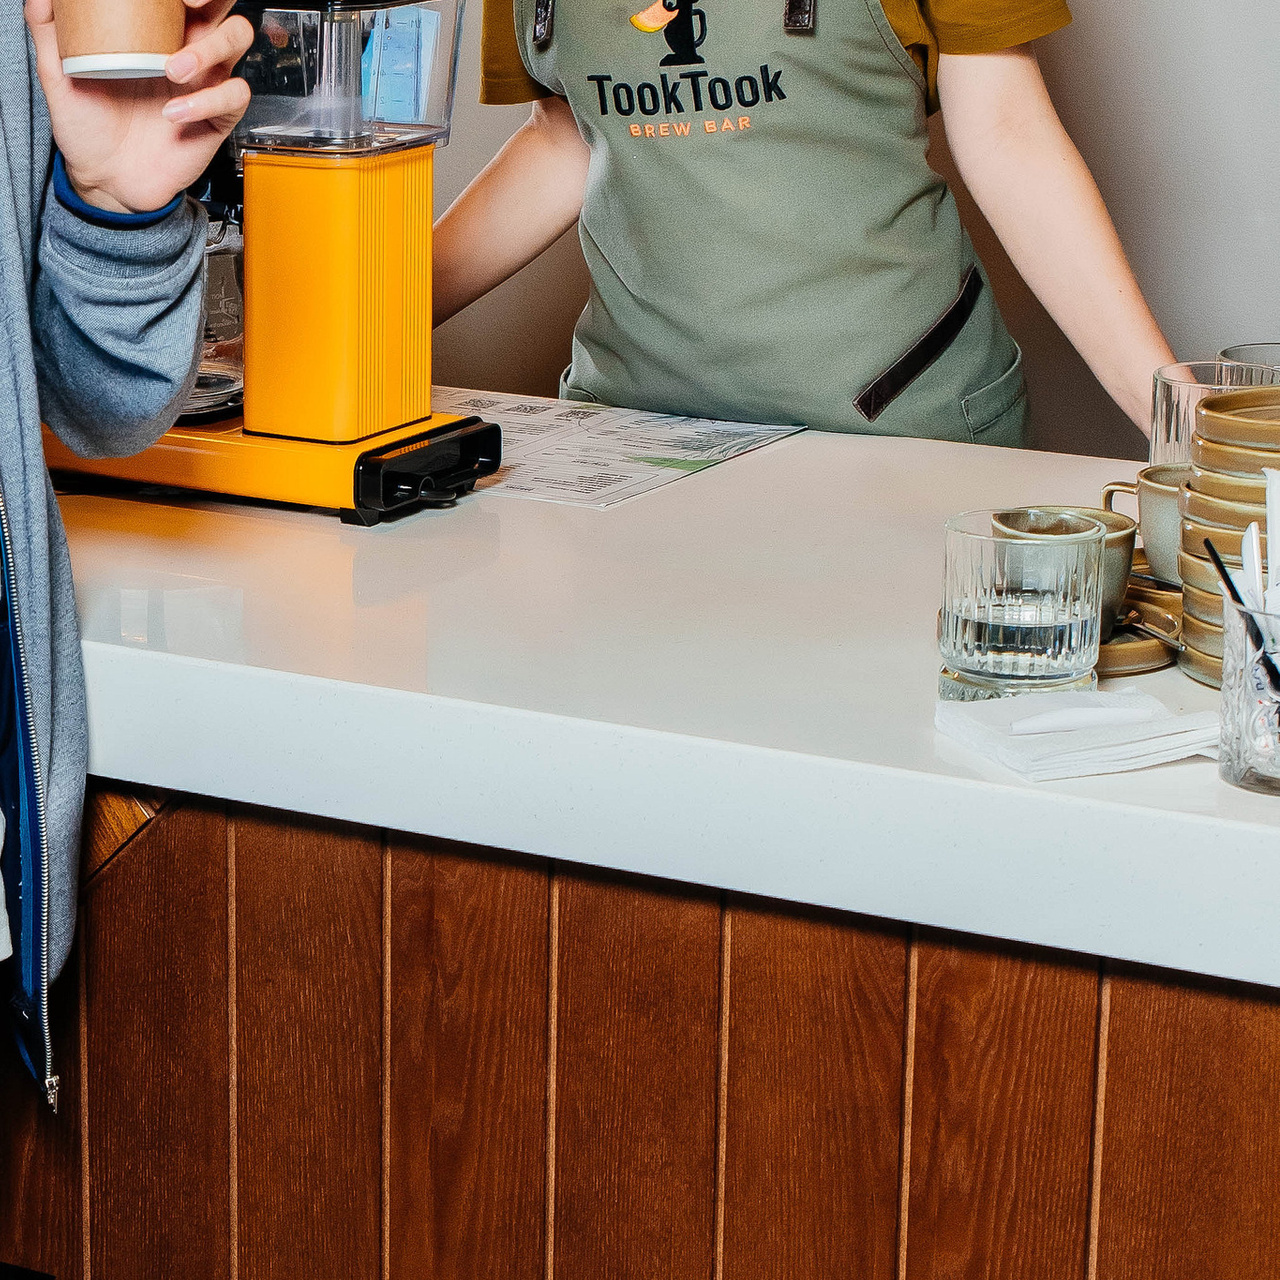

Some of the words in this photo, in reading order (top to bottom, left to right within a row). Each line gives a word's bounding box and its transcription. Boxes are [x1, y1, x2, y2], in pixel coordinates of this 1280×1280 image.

[587, 64, 787, 116] TookTook
[629, 121, 691, 138] BREW
[704, 116, 752, 134] BAR
